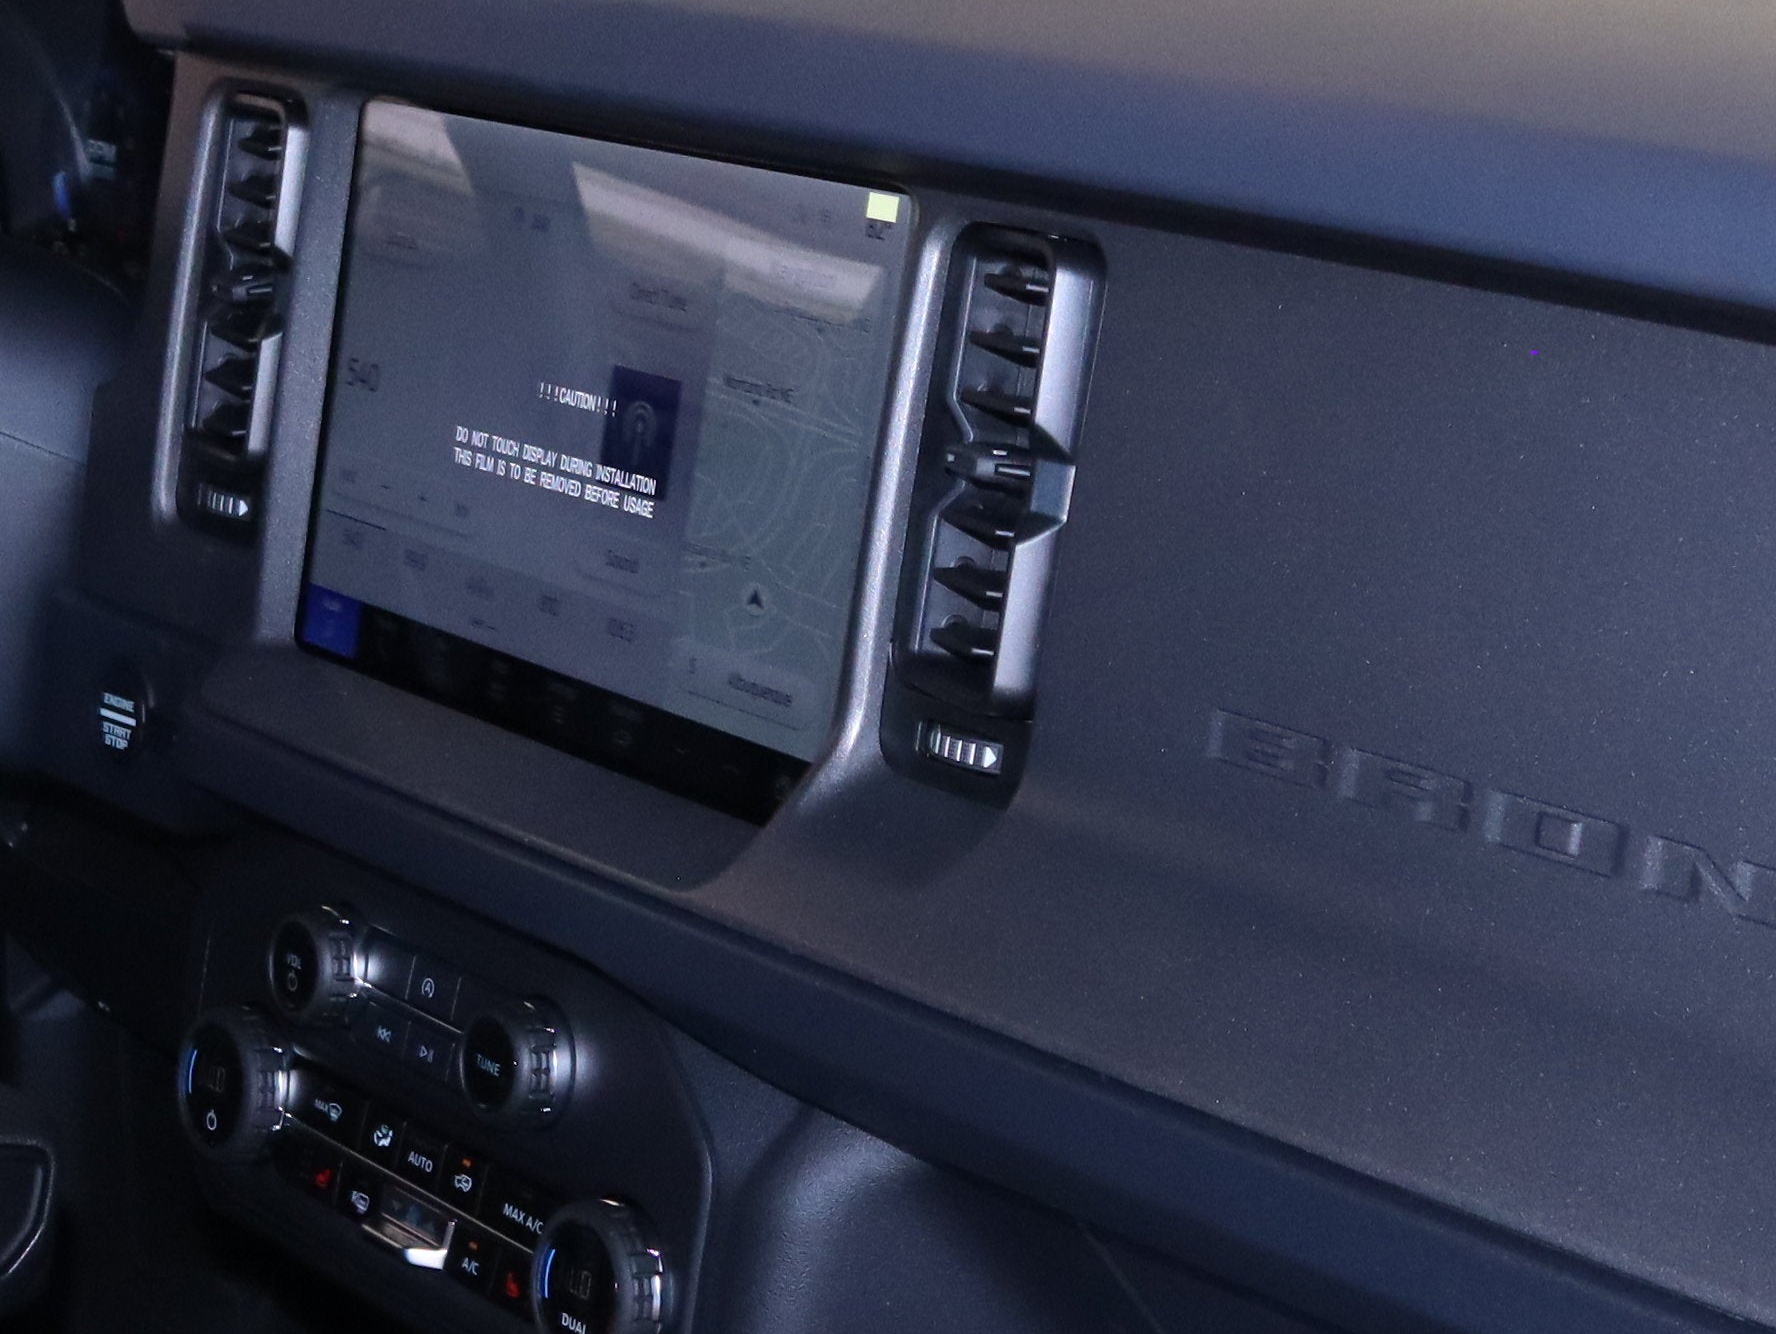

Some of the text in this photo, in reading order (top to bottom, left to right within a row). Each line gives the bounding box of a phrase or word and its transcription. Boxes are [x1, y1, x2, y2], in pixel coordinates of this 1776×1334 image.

[455, 425, 657, 496] DO NOT TOUCH DISPLAY DURING INSTALLATION
[453, 447, 655, 518] THIS FILM IS TO BE REMOVED BEFORE USAGE
[103, 692, 135, 713] ENGINE
[102, 721, 132, 740] START
[104, 733, 128, 750] STOP
[476, 1053, 501, 1077] TUNE
[407, 1150, 433, 1173] AUTO
[502, 1202, 543, 1235] MAX A/C
[461, 1256, 480, 1276] A/C
